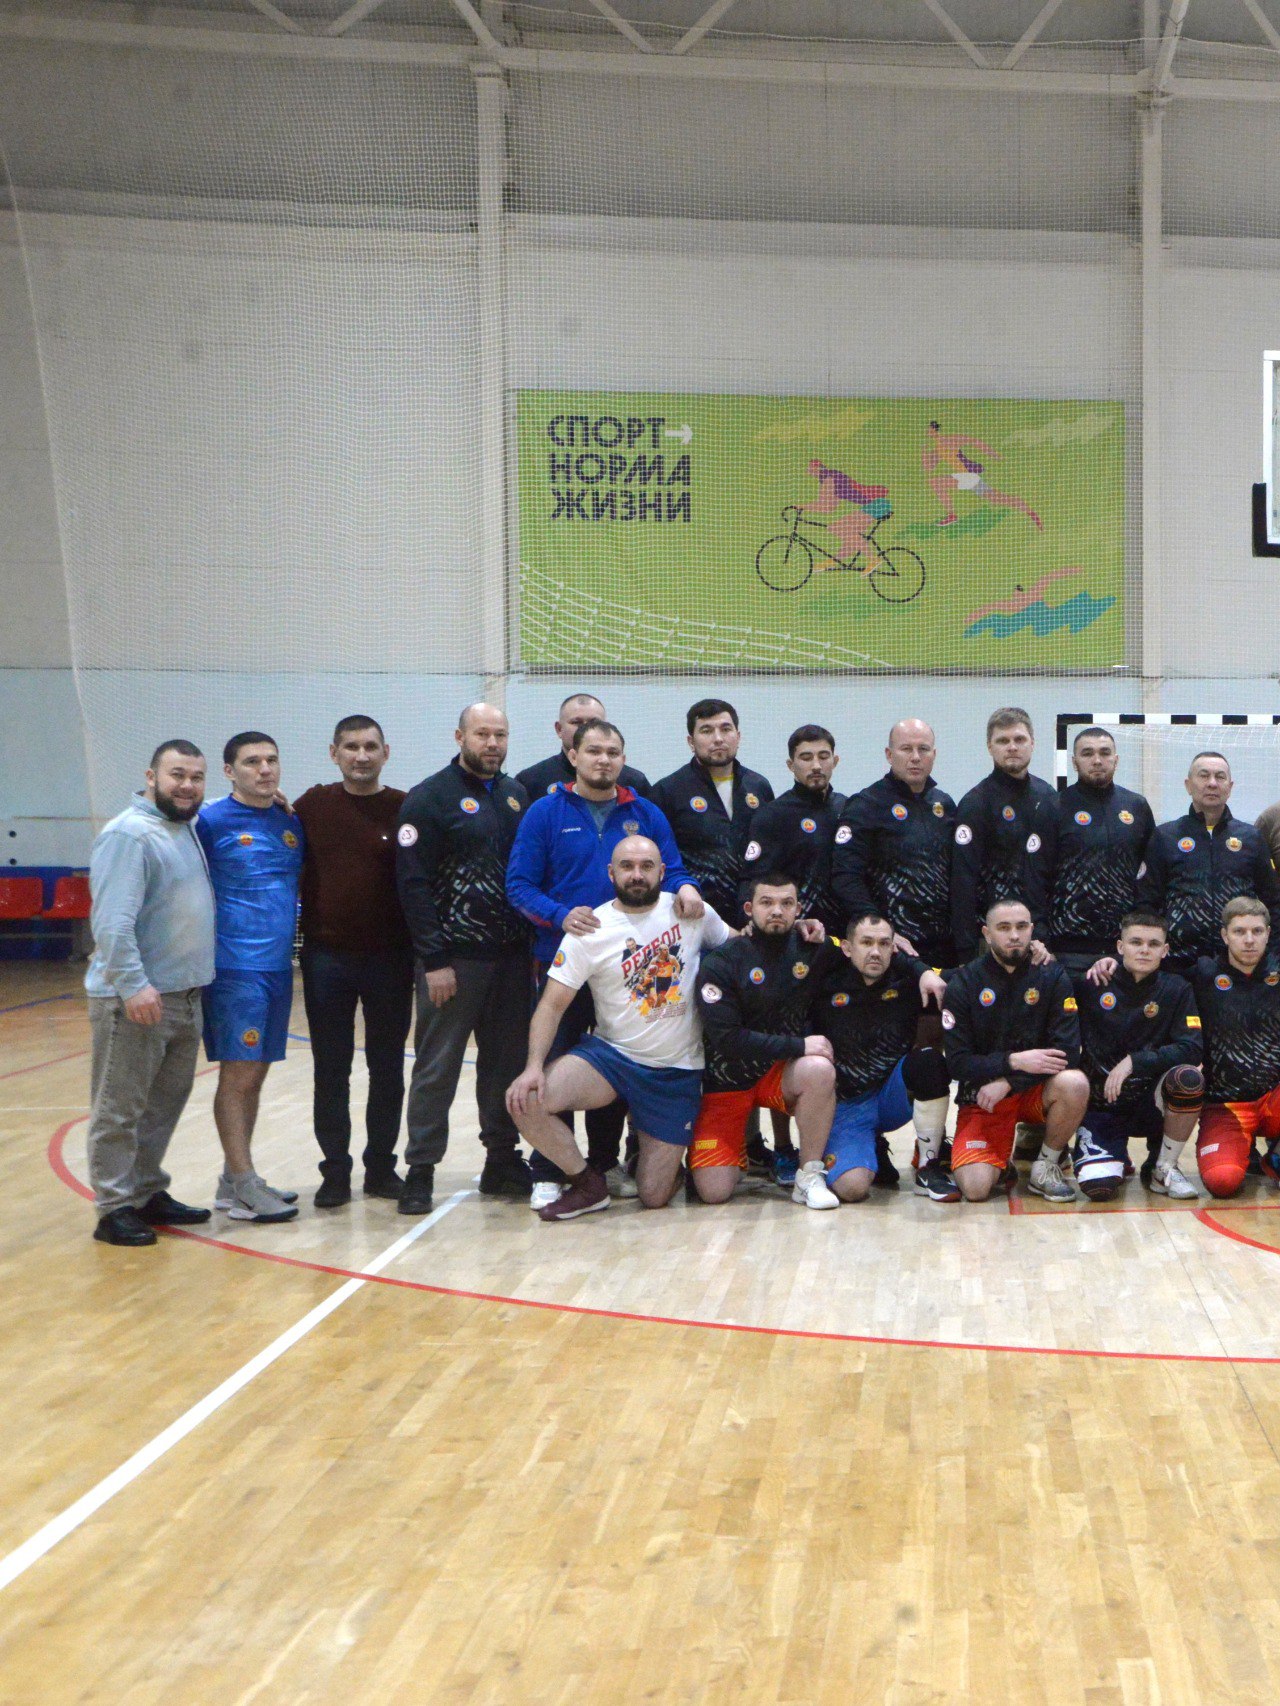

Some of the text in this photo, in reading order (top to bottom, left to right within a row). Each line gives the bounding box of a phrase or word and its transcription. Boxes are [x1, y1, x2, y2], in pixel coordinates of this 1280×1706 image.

[547, 414, 666, 449] СПОРТ
[550, 452, 691, 486] НОРМА
[550, 488, 691, 523] ЖИЗНИ
